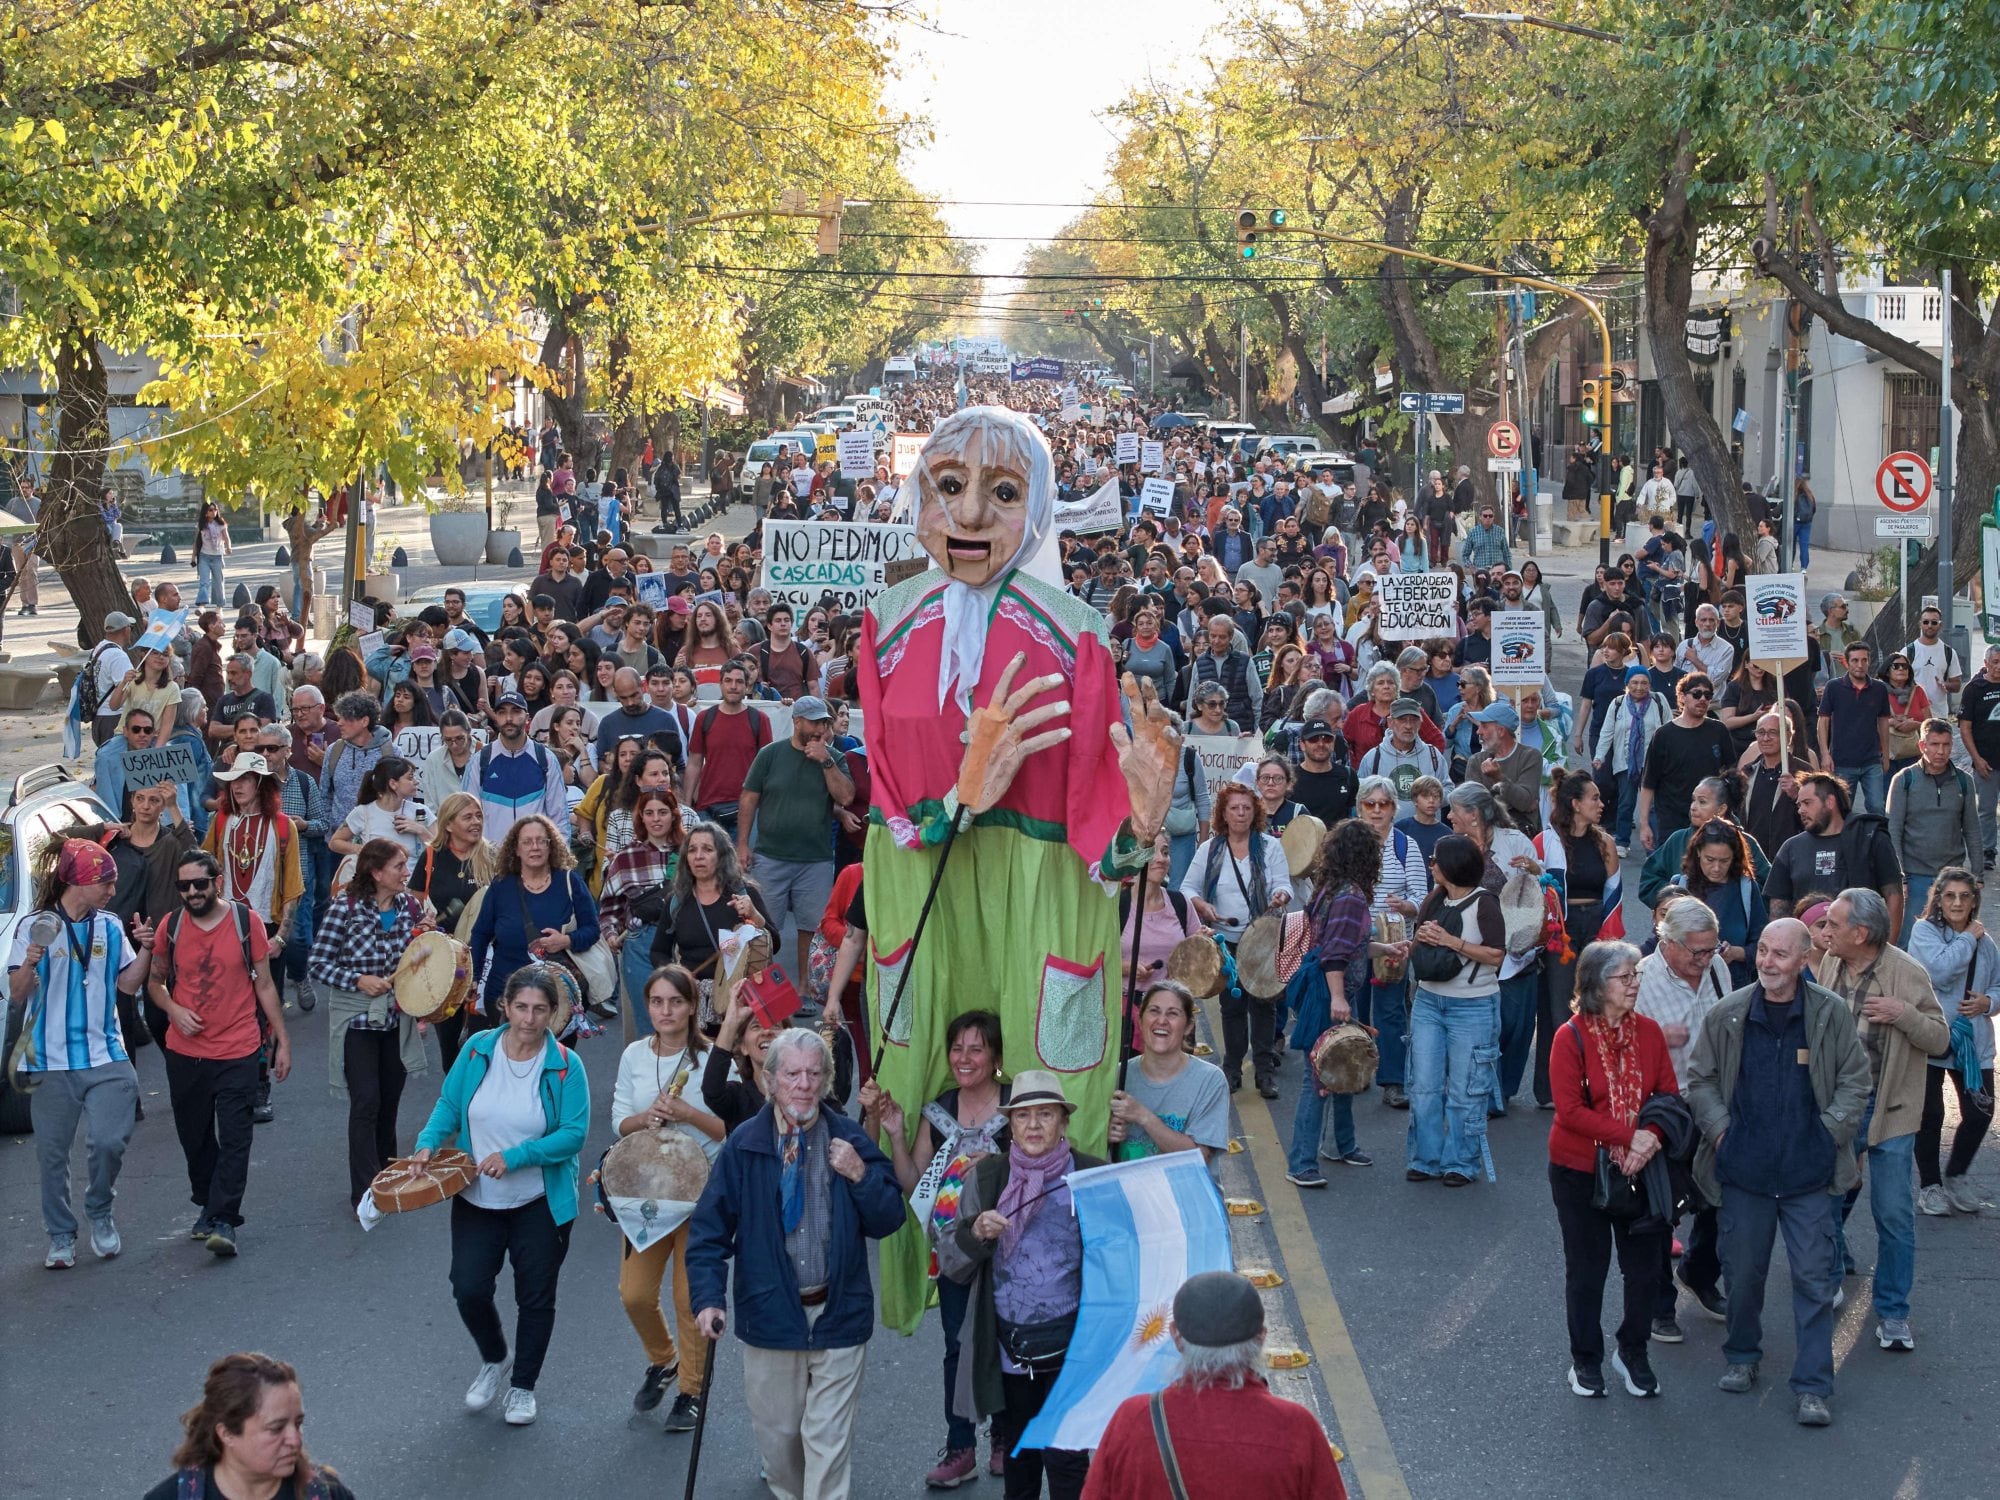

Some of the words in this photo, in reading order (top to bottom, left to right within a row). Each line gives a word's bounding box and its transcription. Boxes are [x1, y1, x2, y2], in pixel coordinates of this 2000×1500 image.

[1276, 210, 1284, 224] 2
[857, 401, 894, 413] ASAMBLEA
[857, 414, 868, 422] DEL
[1894, 467, 1913, 498] E
[1151, 496, 1161, 504] FIN
[773, 528, 810, 562] NO
[769, 562, 866, 585] CASCADAS
[1382, 577, 1394, 587] LA
[1396, 576, 1454, 586] VERDADERA
[1383, 586, 1451, 602] LIBERTAD
[1386, 602, 1400, 612] TE
[1429, 602, 1443, 612] LA
[1380, 611, 1451, 628] EDUCACIÓN
[1258, 660, 1271, 671] 12
[122, 749, 192, 772] USPALLATA
